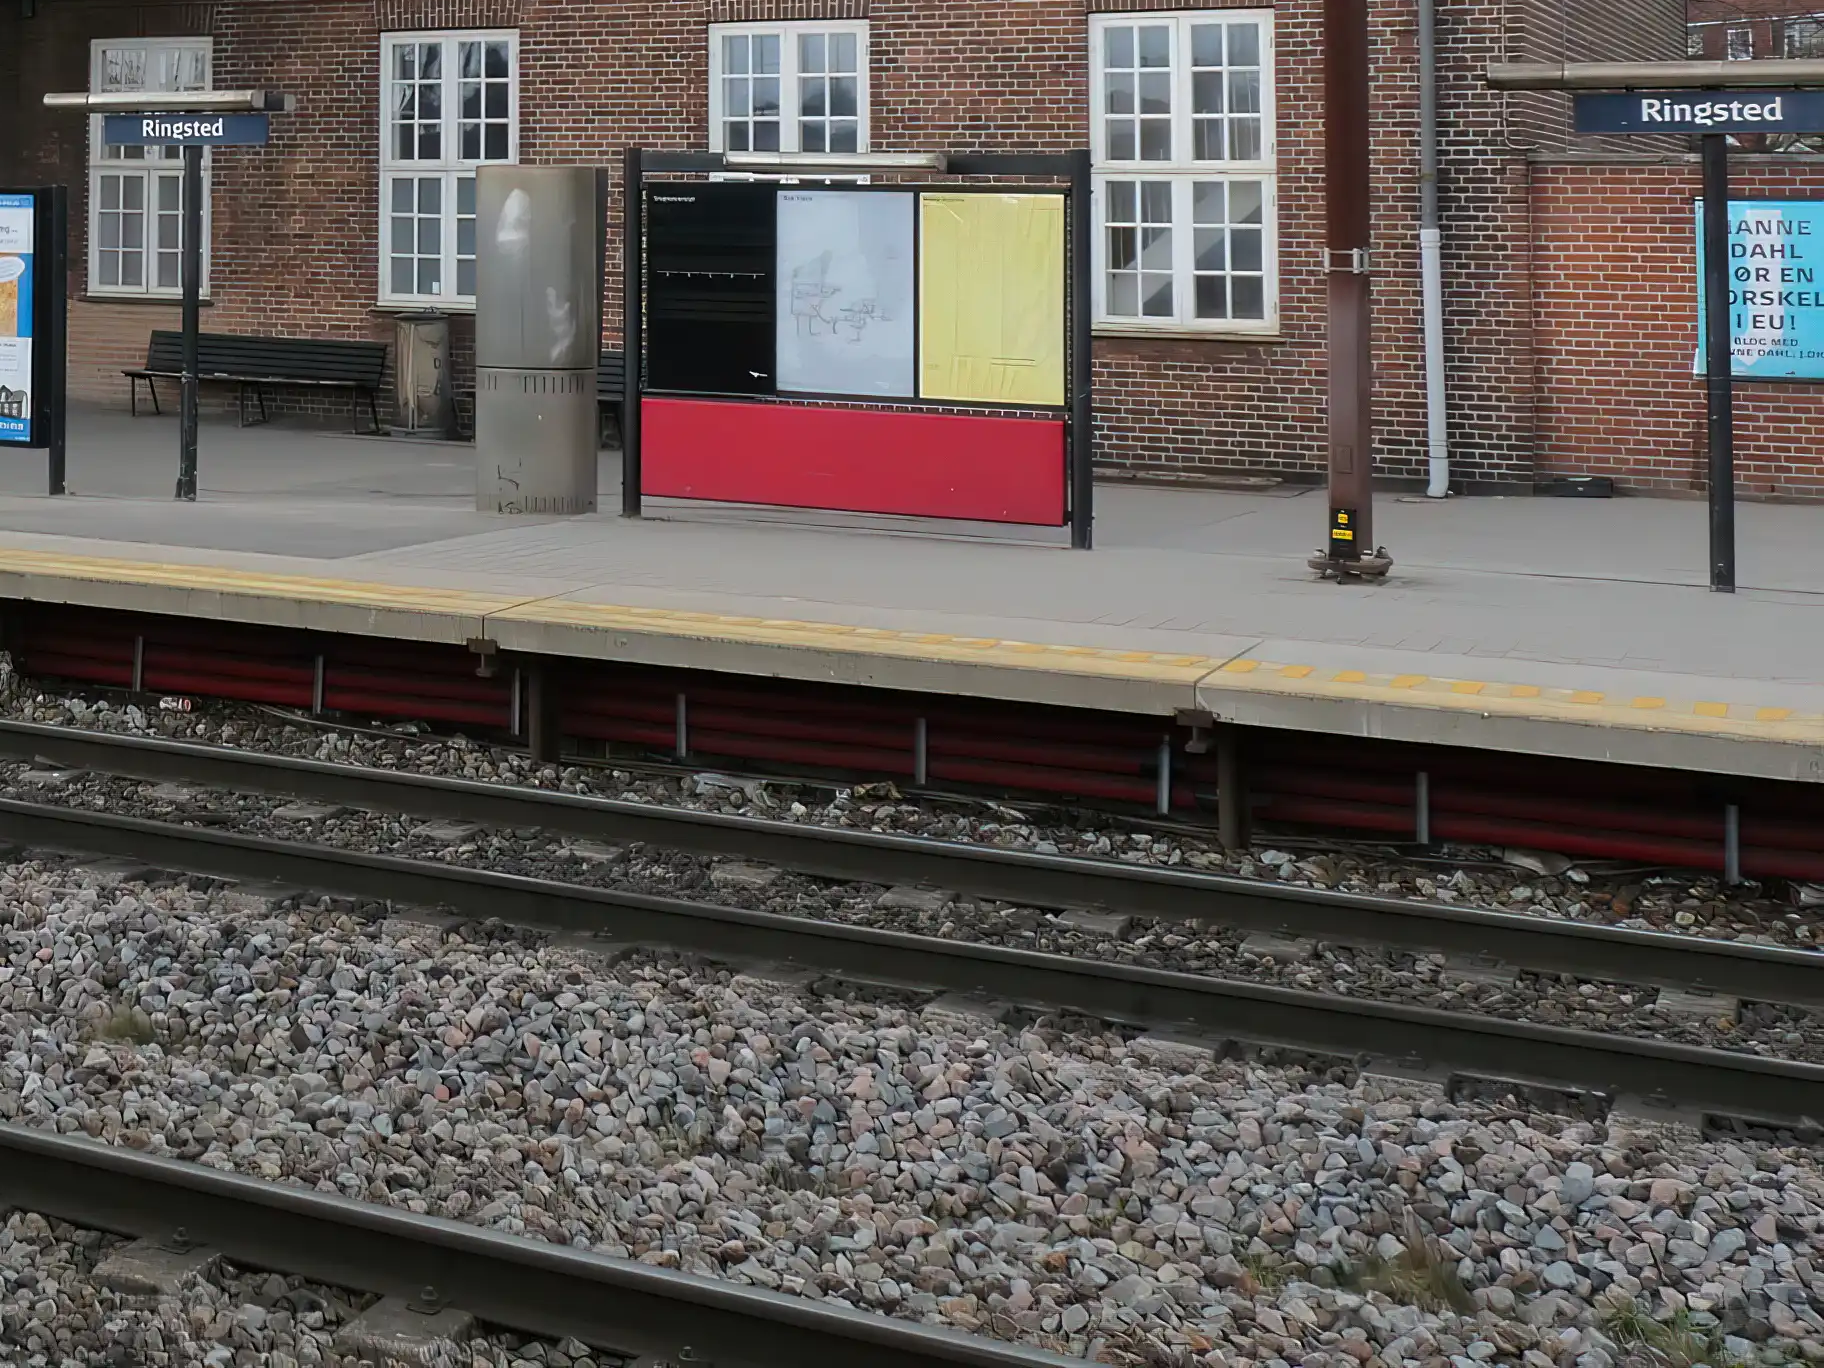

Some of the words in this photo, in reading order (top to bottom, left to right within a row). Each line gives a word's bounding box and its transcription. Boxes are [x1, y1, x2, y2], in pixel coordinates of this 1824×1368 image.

[1641, 96, 1784, 126] Ringsted
[142, 117, 224, 140] Ringsted
[1731, 243, 1804, 259] DAHL
[1734, 266, 1771, 283] ØR
[1780, 267, 1814, 283] EN
[1728, 289, 1824, 308] ORSKEL
[1752, 314, 1796, 330] EU!
